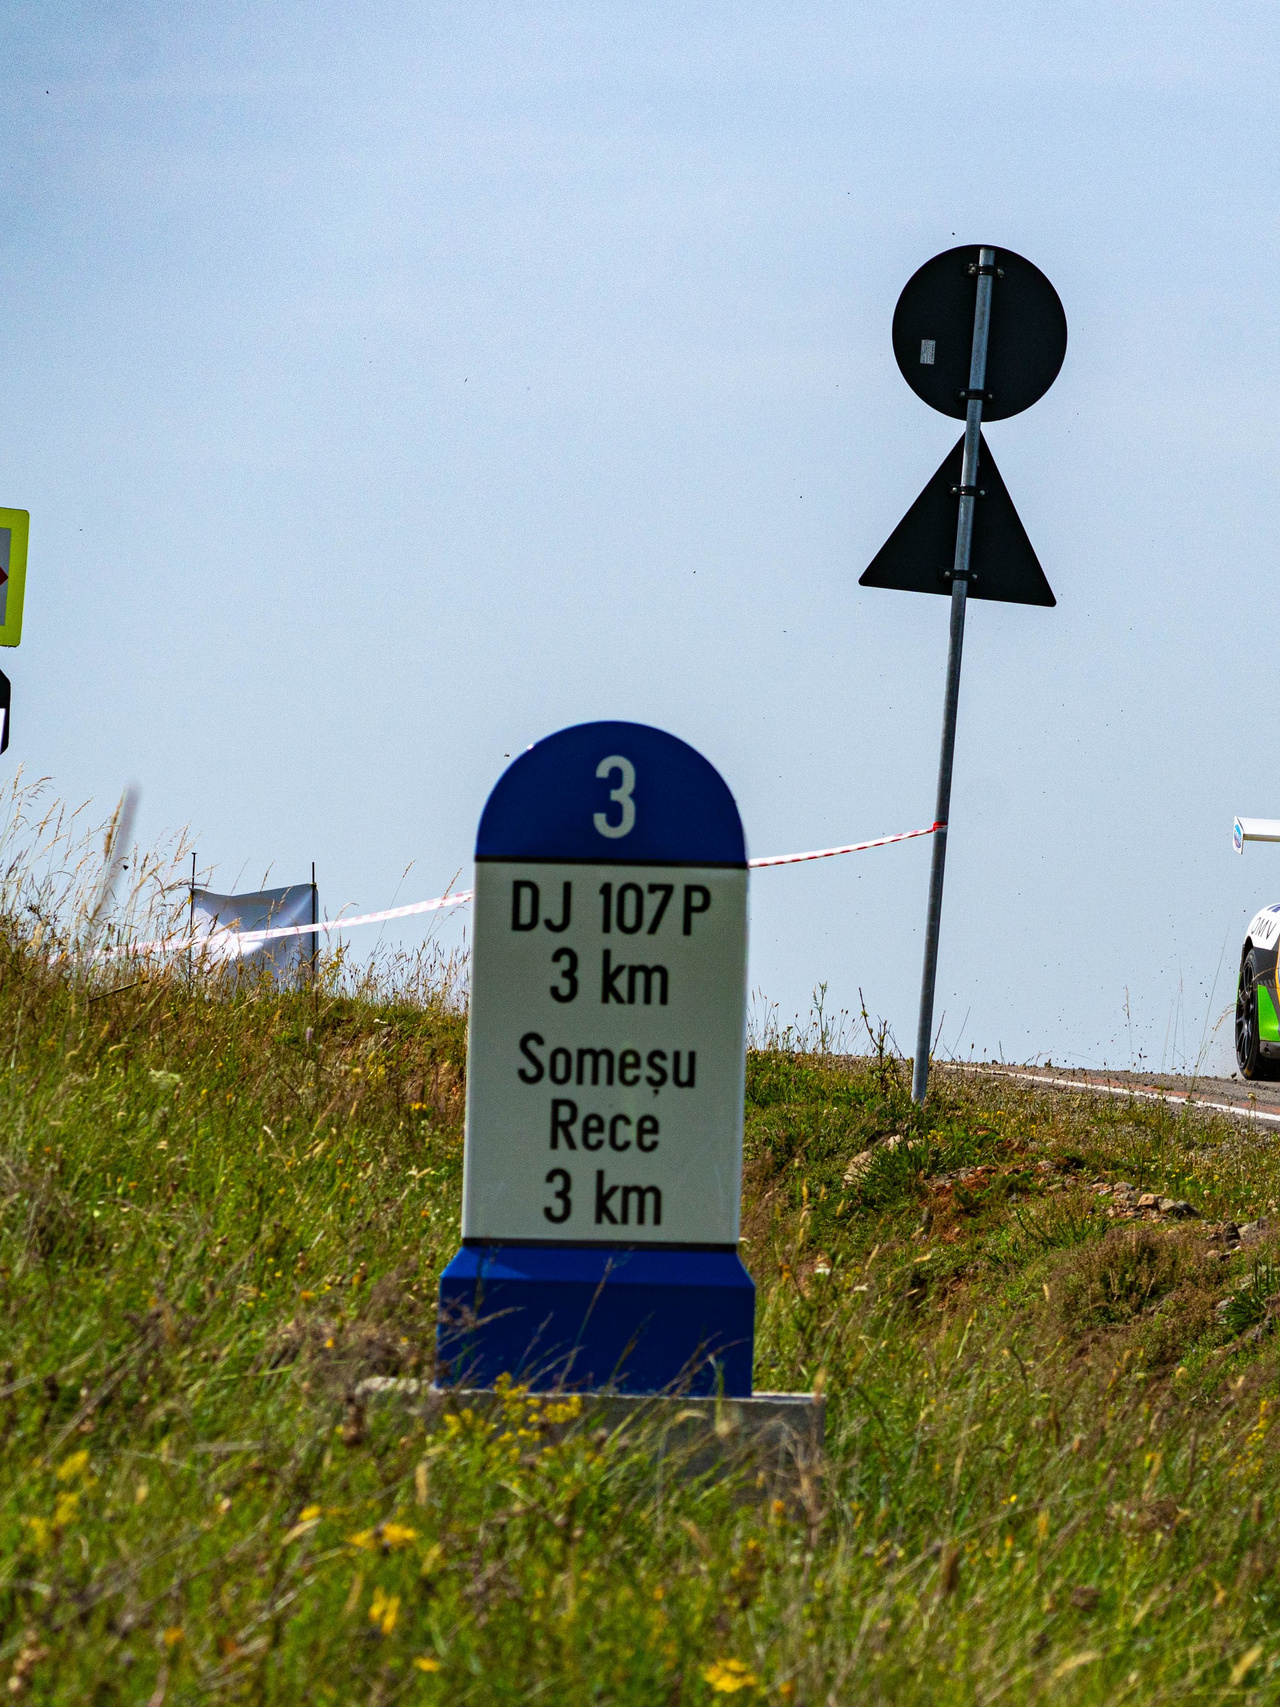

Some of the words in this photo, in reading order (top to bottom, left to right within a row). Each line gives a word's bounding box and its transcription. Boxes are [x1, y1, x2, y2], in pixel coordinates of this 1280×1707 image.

[593, 754, 637, 839] 3
[511, 880, 572, 933] DJ
[549, 947, 579, 1003] 3
[600, 949, 669, 1006] km
[517, 1031, 698, 1096] Someșu
[549, 1099, 661, 1153] Rece
[543, 1168, 573, 1225] 3
[593, 1170, 663, 1227] km
